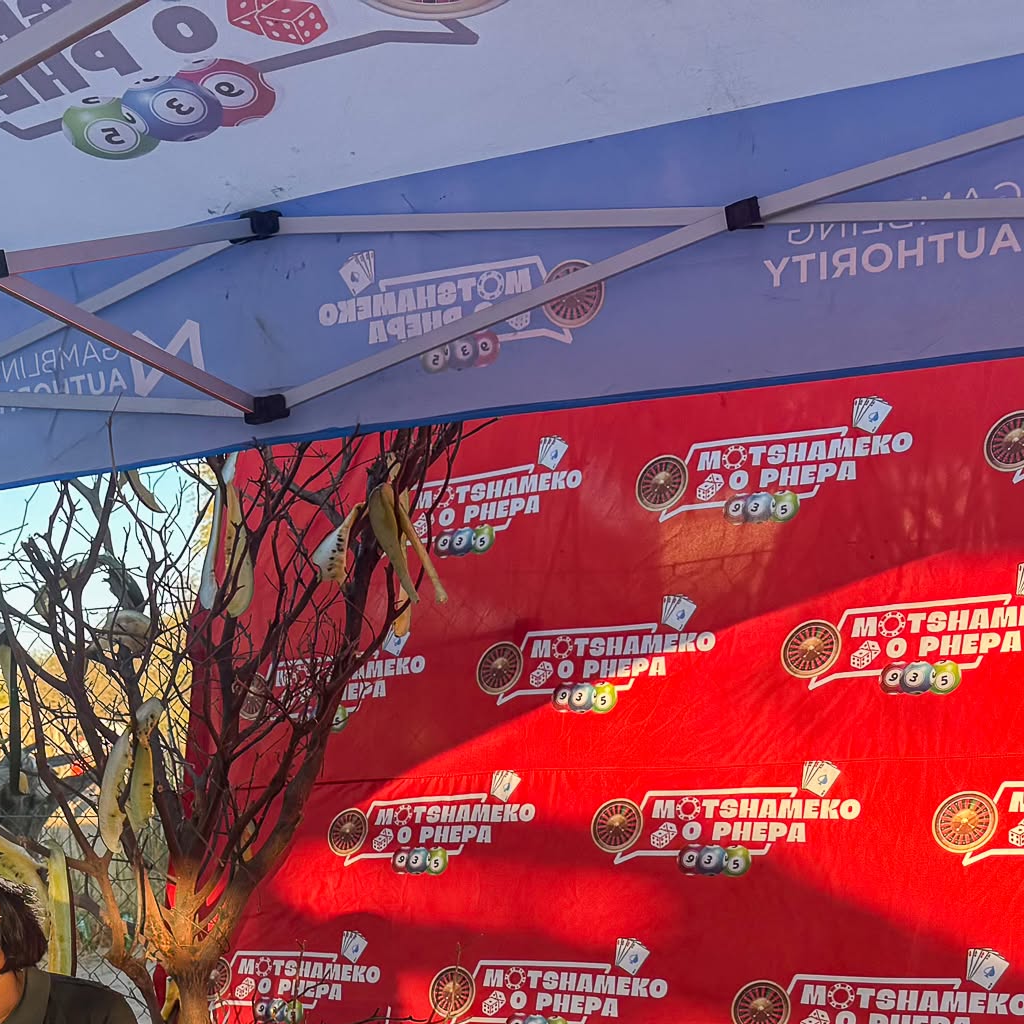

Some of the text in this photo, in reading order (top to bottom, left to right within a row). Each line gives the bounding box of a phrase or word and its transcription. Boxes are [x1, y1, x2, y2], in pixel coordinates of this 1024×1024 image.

[697, 431, 913, 471] MOTSHAMEKO
[728, 460, 857, 490] O PHEPA
[415, 470, 583, 510] MOTSHAMEKO
[438, 495, 540, 526] O PHEPA
[732, 502, 788, 515] 9 3 5
[440, 537, 486, 548] 9 3 5
[850, 606, 1024, 638] MOTSHAM
[529, 631, 716, 659] MOTSHAMEKO
[886, 630, 1022, 659] O PHEPA
[557, 656, 666, 679] O PHEPA
[888, 672, 949, 686] 9 3 5
[341, 679, 387, 700] EPA
[559, 691, 607, 706] 9 3 5
[374, 803, 536, 826] MOTSHAMEKO
[651, 796, 861, 821] MOTSHAMEKO
[397, 825, 492, 844] O PHEPA
[681, 821, 806, 843] O PHEPA
[397, 855, 440, 868] 9 3 5
[685, 854, 740, 869] 9 3 5
[237, 956, 381, 984] MOTSHAMEKO
[257, 977, 342, 1001] O PHEPA
[482, 966, 668, 999] MOTSHAMEKO
[509, 991, 619, 1018] O PHEPA
[800, 983, 1024, 1016] MOTSHAMEKO
